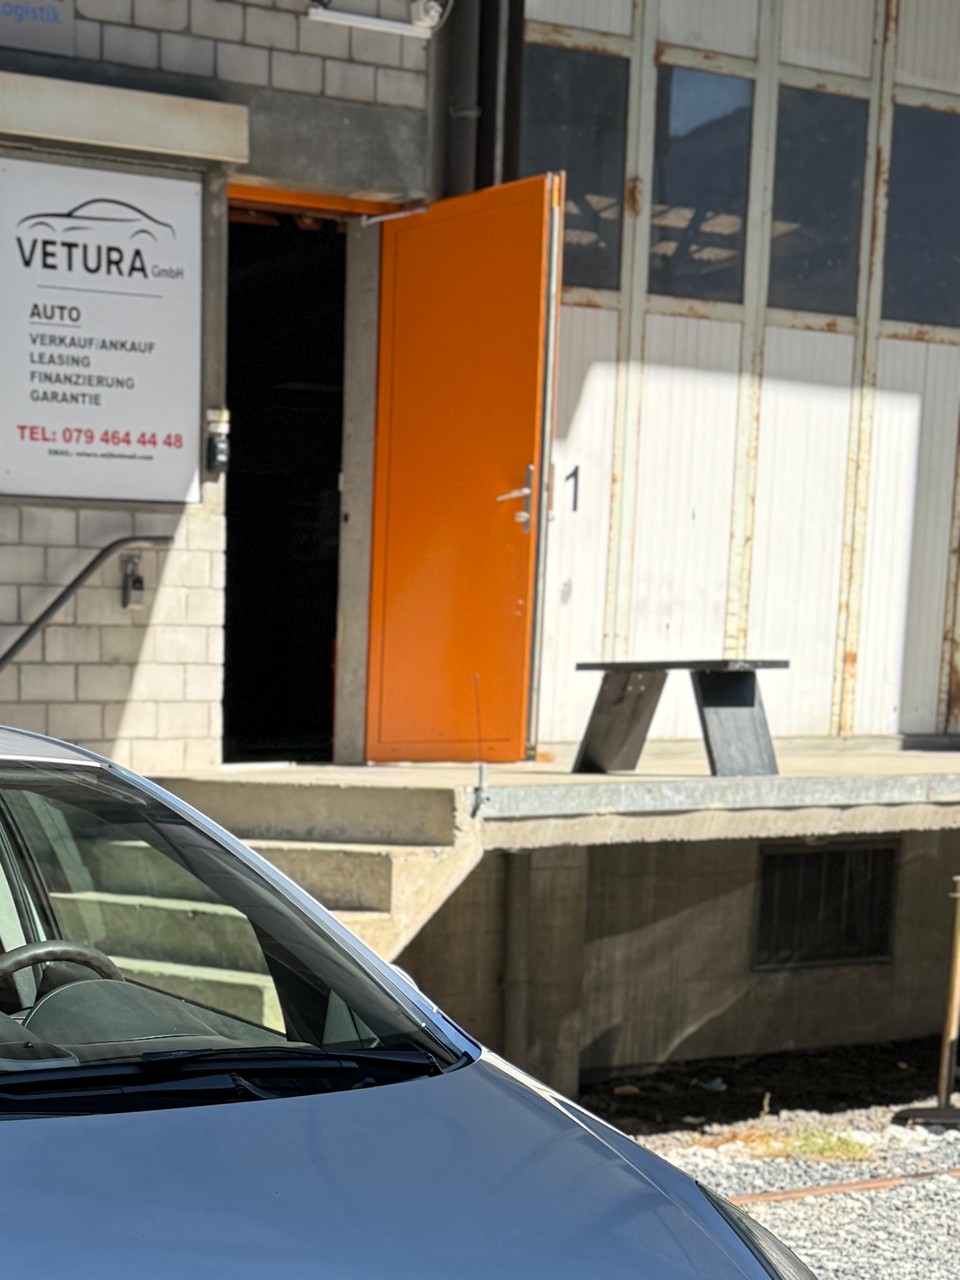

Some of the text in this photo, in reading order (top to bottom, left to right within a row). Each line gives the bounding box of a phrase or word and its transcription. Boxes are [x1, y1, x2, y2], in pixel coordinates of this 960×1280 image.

[17, 236, 185, 280] VETURA GmbH
[29, 303, 81, 322] AUTO
[29, 351, 91, 368] LEASING
[29, 371, 135, 390] FINANZIERUNG
[29, 389, 102, 406] GARANTIE
[17, 425, 183, 449] TEL: 079 464 44 48
[564, 465, 580, 512] 1
